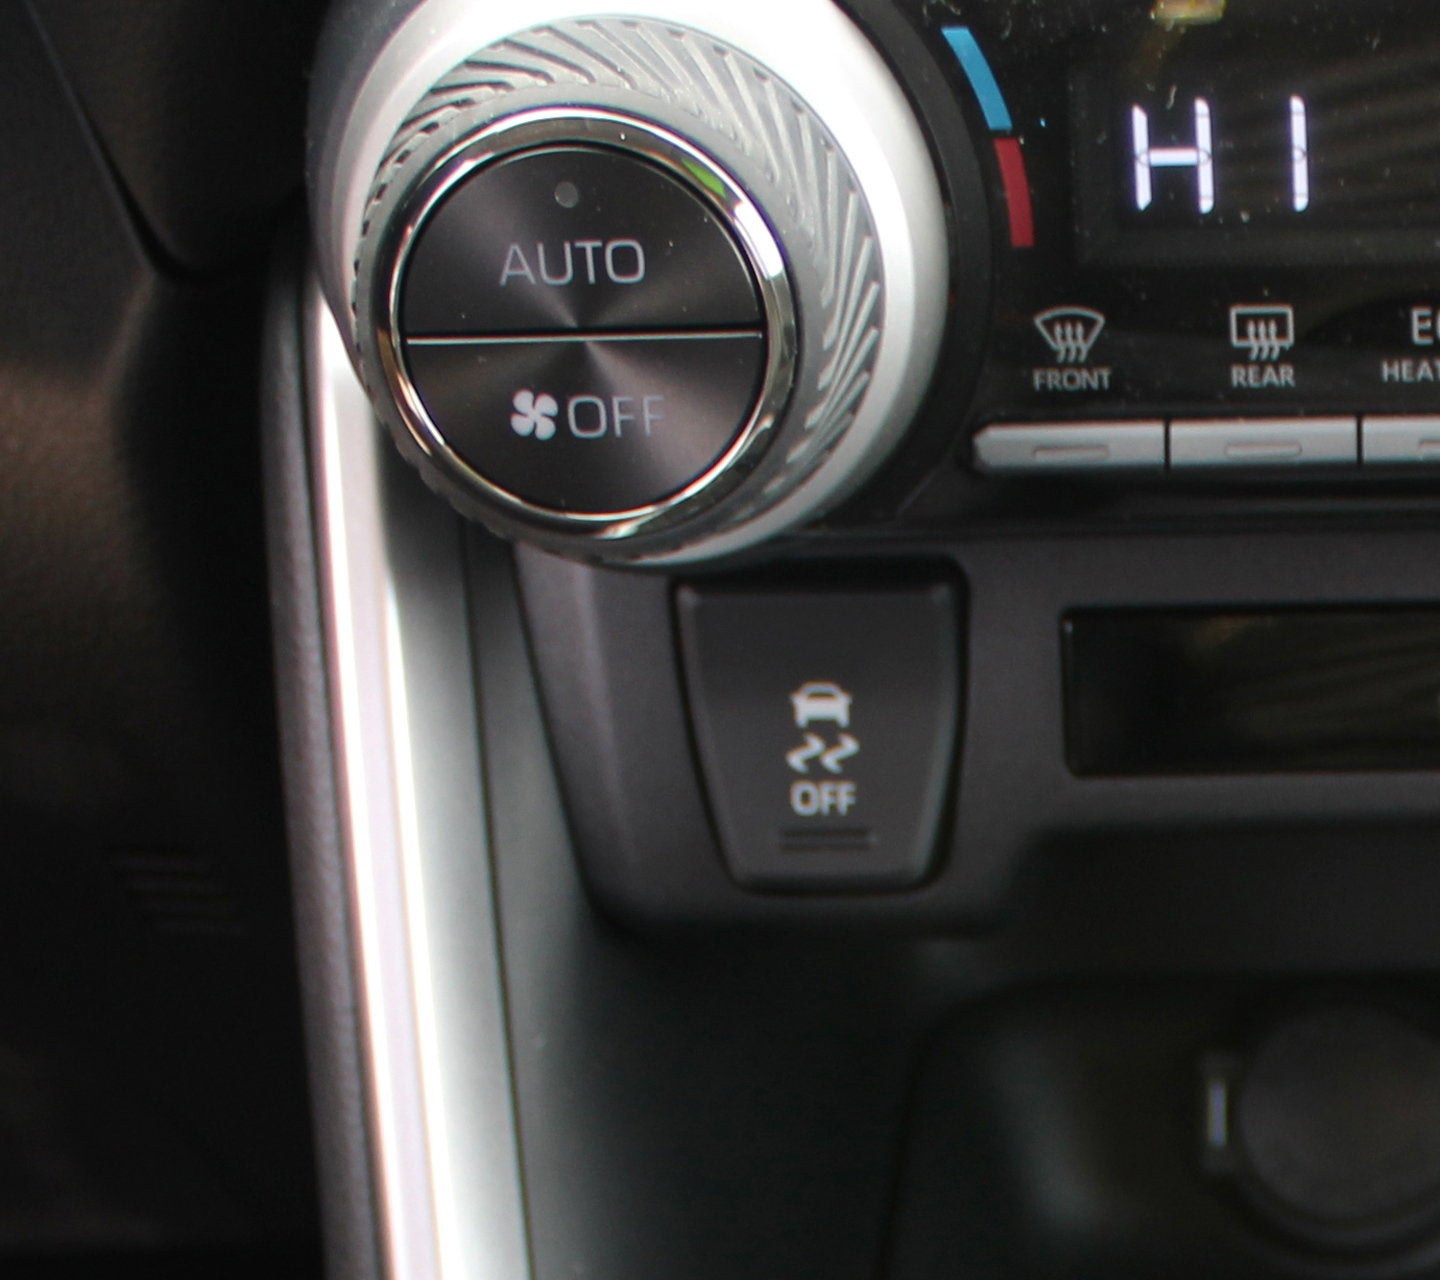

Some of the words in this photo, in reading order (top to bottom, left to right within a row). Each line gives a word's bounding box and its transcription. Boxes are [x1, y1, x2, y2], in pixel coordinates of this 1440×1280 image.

[499, 238, 646, 287] AUTO
[1032, 367, 1112, 392] FRONT
[1230, 364, 1296, 388] REAR
[567, 394, 666, 439] OFF
[790, 781, 856, 816] OFF
